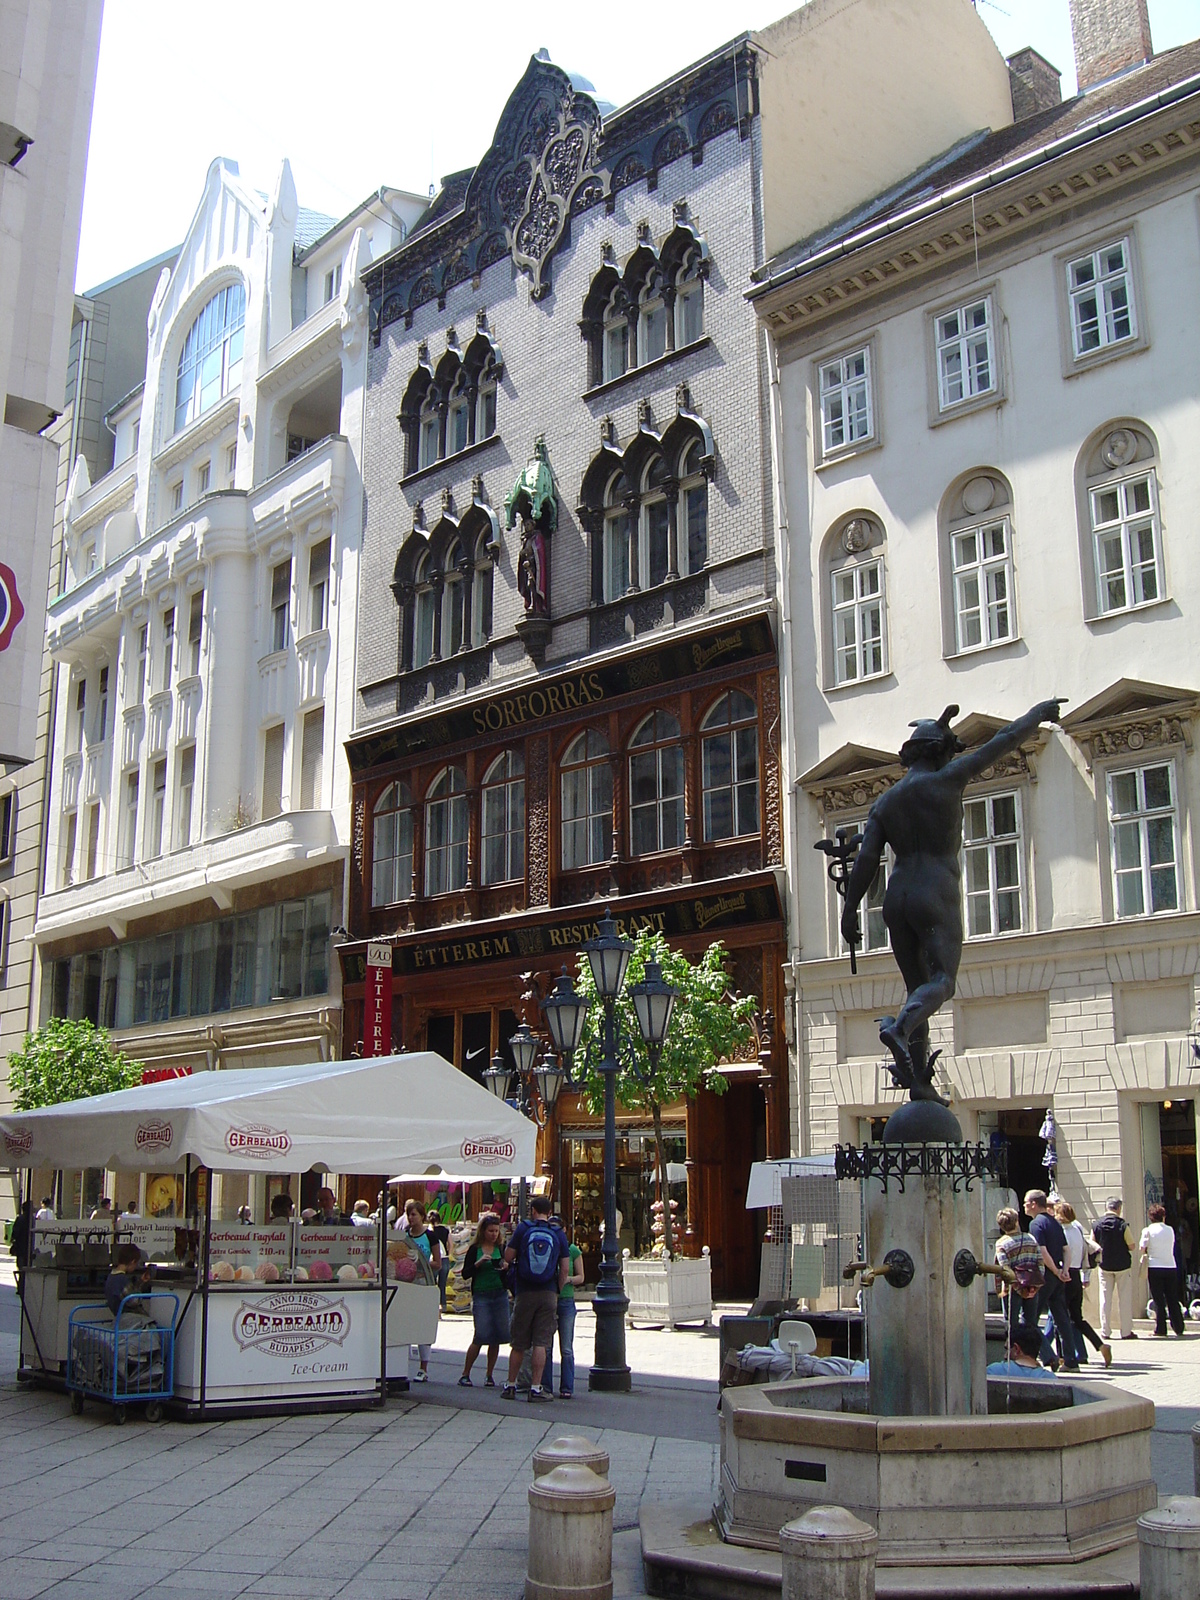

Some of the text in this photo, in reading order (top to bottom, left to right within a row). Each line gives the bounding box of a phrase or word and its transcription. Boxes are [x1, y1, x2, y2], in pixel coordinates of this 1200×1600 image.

[473, 673, 604, 735] SÖRFORRÁS
[549, 912, 666, 946] RESTARANT
[413, 936, 511, 967] ÉTTEREM
[372, 968, 384, 1059] ÉTTERE
[137, 1129, 171, 1144] GERBEAUD
[229, 1132, 289, 1149] GERBEAUD
[464, 1143, 513, 1156] GERBEAUD
[209, 1231, 286, 1245] Gerbeaud Fagylalt
[300, 1232, 374, 1242] Gerbeaud Ice-Cream
[269, 1295, 319, 1309] ANNO 1858
[241, 1311, 344, 1339] GERBEAUD
[269, 1340, 316, 1354] BUDAPEST
[291, 1361, 349, 1375] Ice-Cream
